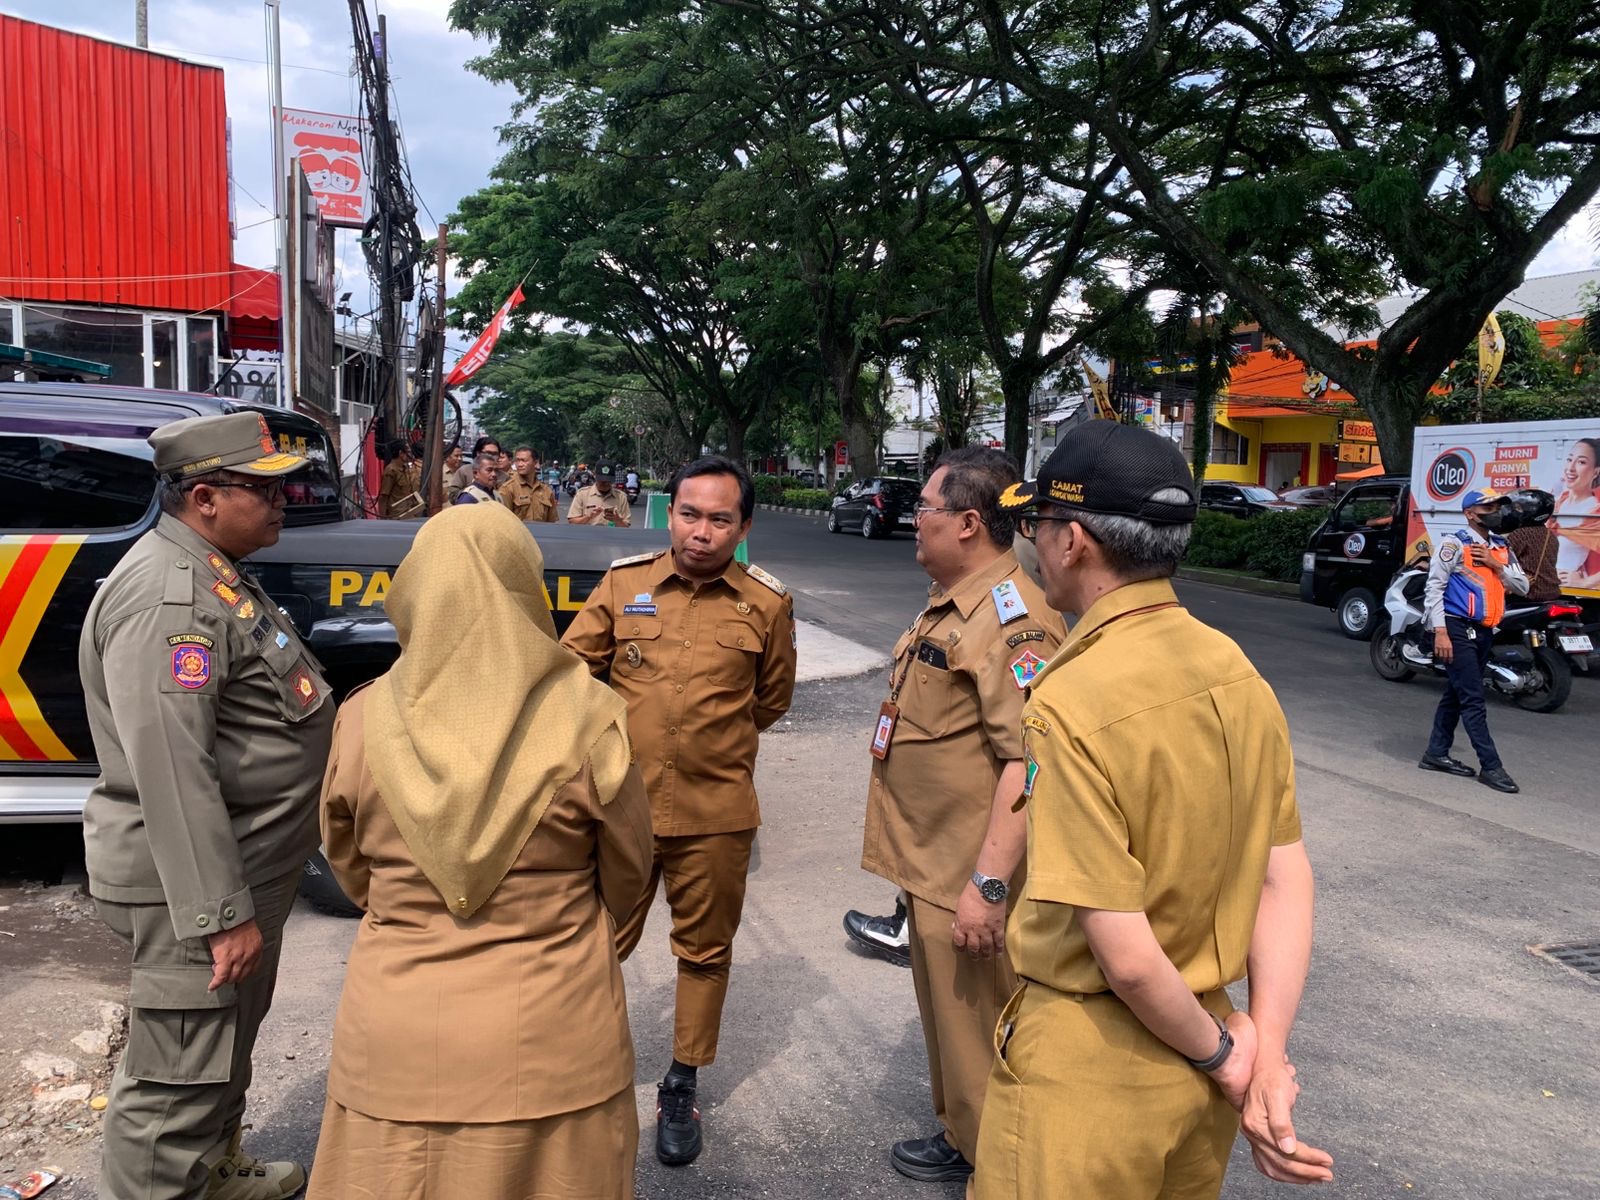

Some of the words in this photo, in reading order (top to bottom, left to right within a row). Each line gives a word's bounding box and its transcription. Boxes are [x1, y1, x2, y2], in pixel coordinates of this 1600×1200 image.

[282, 113, 335, 129] Makaroni
[1499, 448, 1533, 459] MURNI
[1436, 463, 1466, 486] Cleo
[1491, 464, 1528, 474] AIRNYA
[1051, 480, 1083, 494] CAMAT
